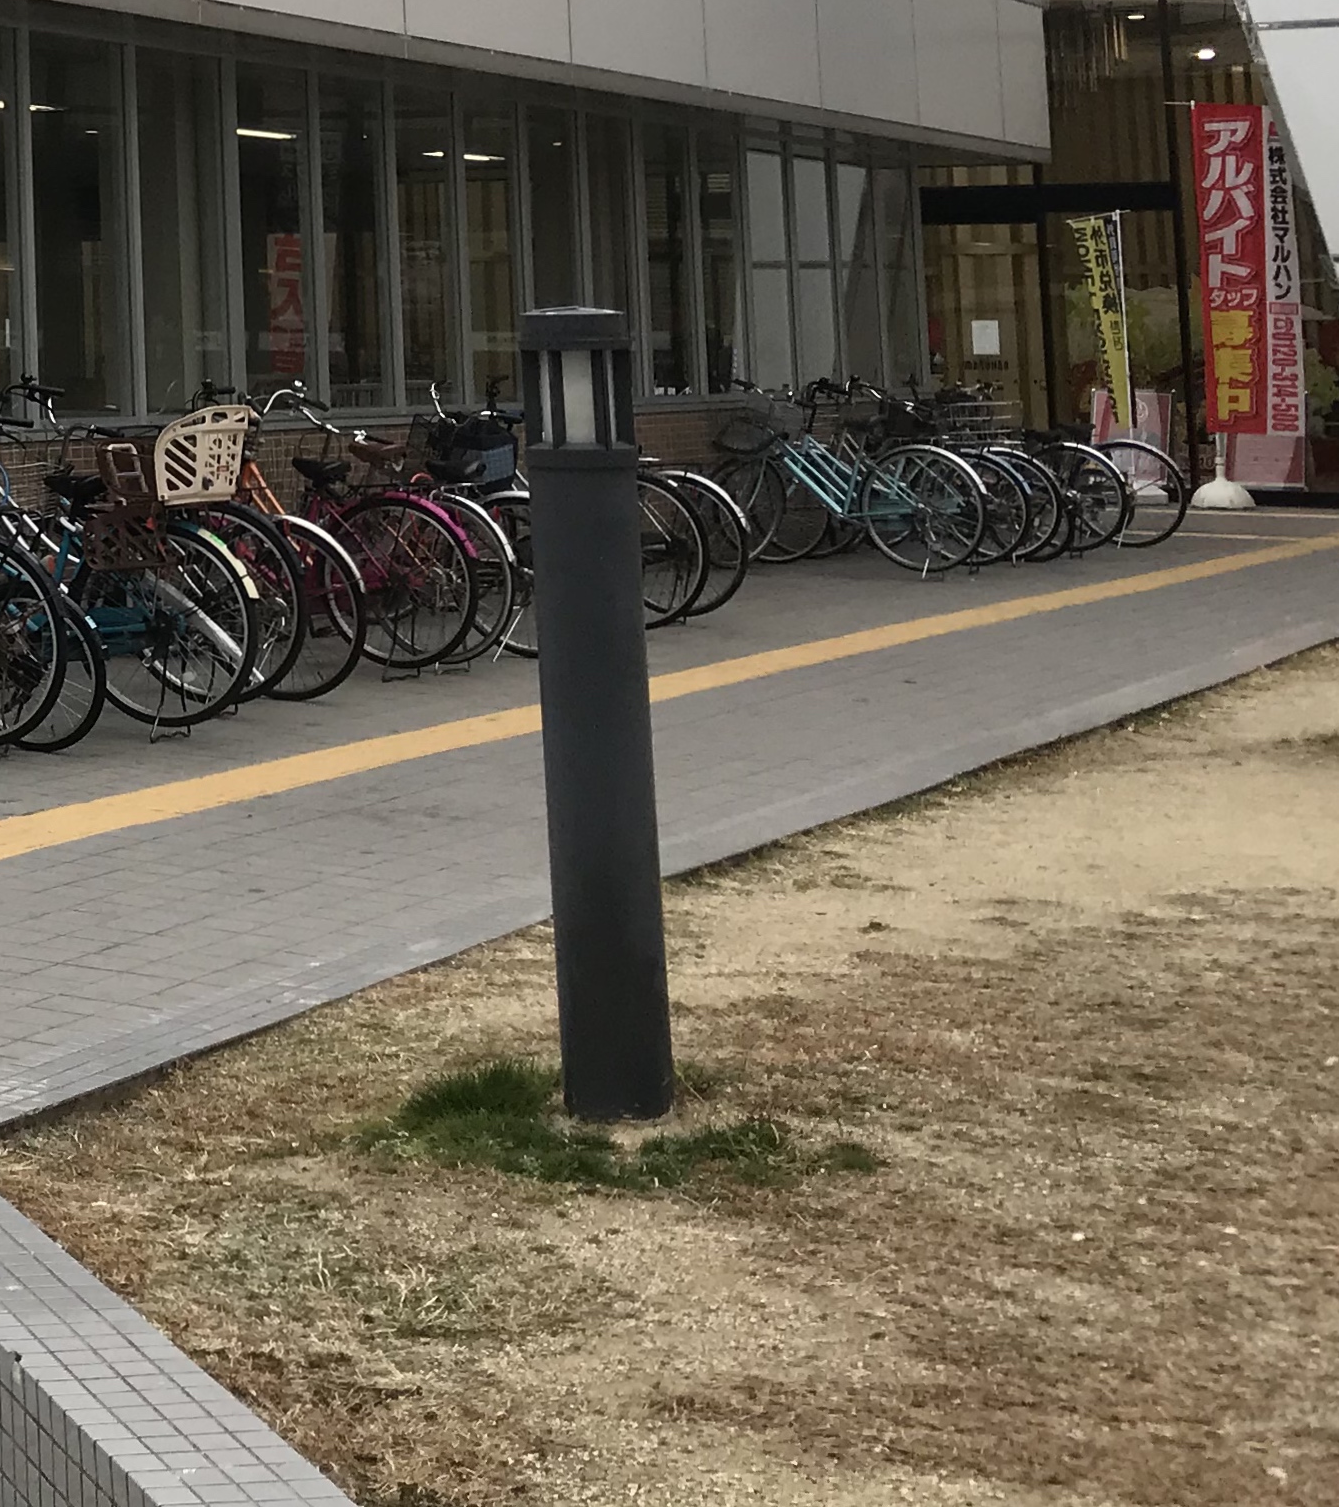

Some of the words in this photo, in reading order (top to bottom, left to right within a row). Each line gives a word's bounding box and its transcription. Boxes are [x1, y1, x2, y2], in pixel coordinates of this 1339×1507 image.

[1202, 120, 1255, 288] アルバイト
[1267, 145, 1293, 300] 株式会社マルハン
